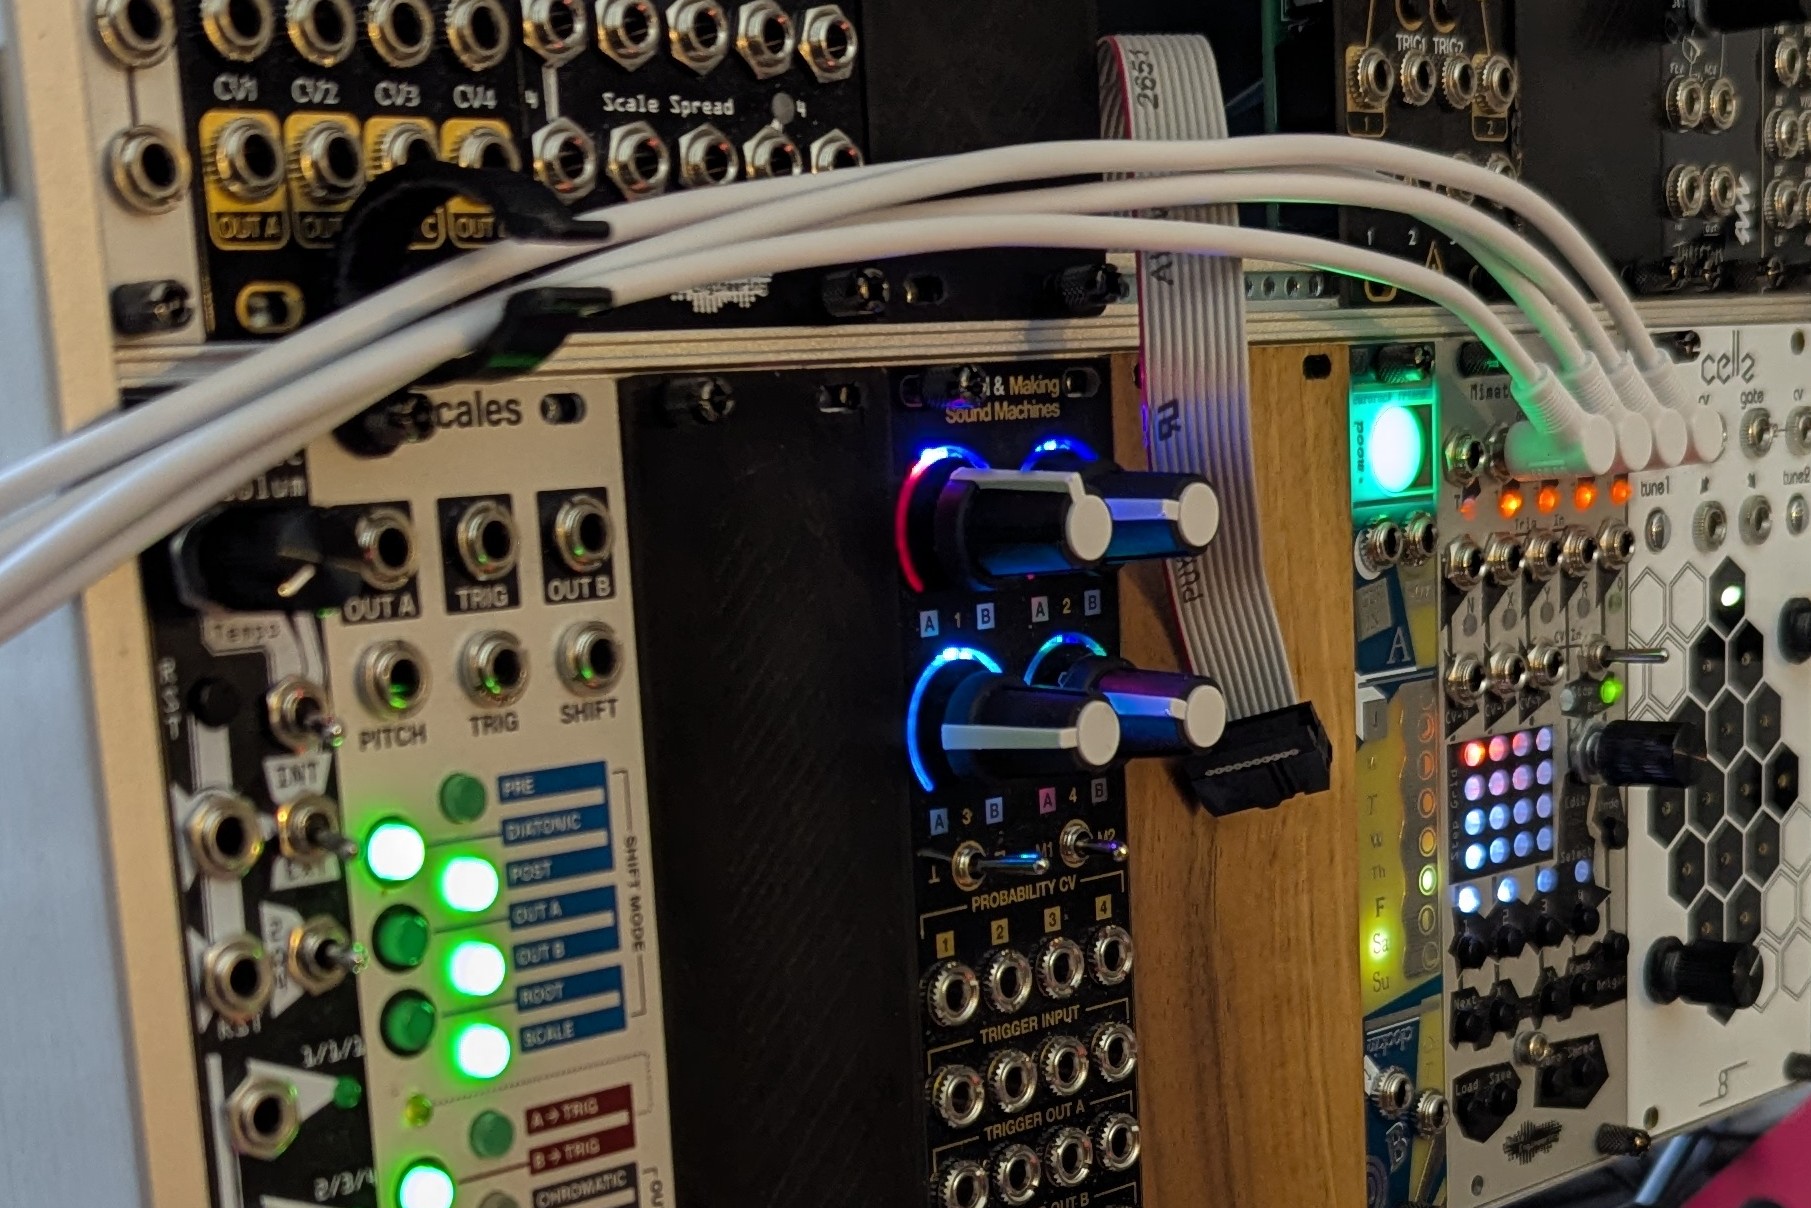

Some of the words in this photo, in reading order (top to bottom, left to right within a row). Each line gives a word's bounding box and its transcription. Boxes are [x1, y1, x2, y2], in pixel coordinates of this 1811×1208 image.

[213, 73, 258, 102] CV1
[291, 76, 340, 105] CV2
[374, 80, 421, 107] CV3
[453, 83, 498, 109] CV4
[602, 92, 660, 113] Scale
[669, 95, 735, 118] Spread
[219, 216, 261, 240] OUT
[1408, 230, 1417, 246] 2
[1009, 375, 1060, 398] Making
[1740, 388, 1765, 410] gate
[432, 391, 524, 429] cales
[945, 401, 992, 425] Sound
[994, 399, 1061, 422] Machines
[1640, 476, 1670, 498] tune1
[1783, 466, 1811, 486] tune2
[456, 583, 510, 609] TRIG
[547, 578, 593, 604] OUT
[594, 575, 612, 598] B
[344, 596, 396, 624] OUT
[398, 593, 419, 620] A
[1062, 597, 1072, 615] 2
[1386, 626, 1411, 664] A
[469, 711, 520, 735] TRIG
[560, 698, 618, 724] SHIFT
[359, 722, 428, 751] PITCH
[504, 778, 536, 797] PRE
[1068, 786, 1078, 804] 4
[507, 812, 583, 842] DIATONIC
[962, 807, 973, 826] 3
[511, 861, 552, 883] POST
[624, 836, 642, 890] SHIFT
[971, 879, 1056, 913] PROBABILITY
[1059, 874, 1078, 893] CV
[513, 903, 548, 925] OUT
[1375, 896, 1386, 918] F
[629, 896, 646, 953] MODE
[516, 944, 550, 966] OUT
[1372, 932, 1389, 953] Sa
[521, 981, 564, 1006] ROOT
[1372, 972, 1390, 993] Su
[523, 1020, 575, 1048] SCALE
[979, 1015, 1039, 1045] TRIGGER
[1041, 1004, 1081, 1029] INPUT
[1455, 1078, 1479, 1096] Load
[529, 1110, 545, 1129] A
[562, 1096, 599, 1121] TRIG
[983, 1110, 1043, 1142] TRIGGER
[1046, 1102, 1073, 1124] OUT
[1075, 1098, 1086, 1114] A
[532, 1151, 546, 1170] B
[563, 1137, 601, 1161] TRIG
[1079, 1191, 1090, 1207] B
